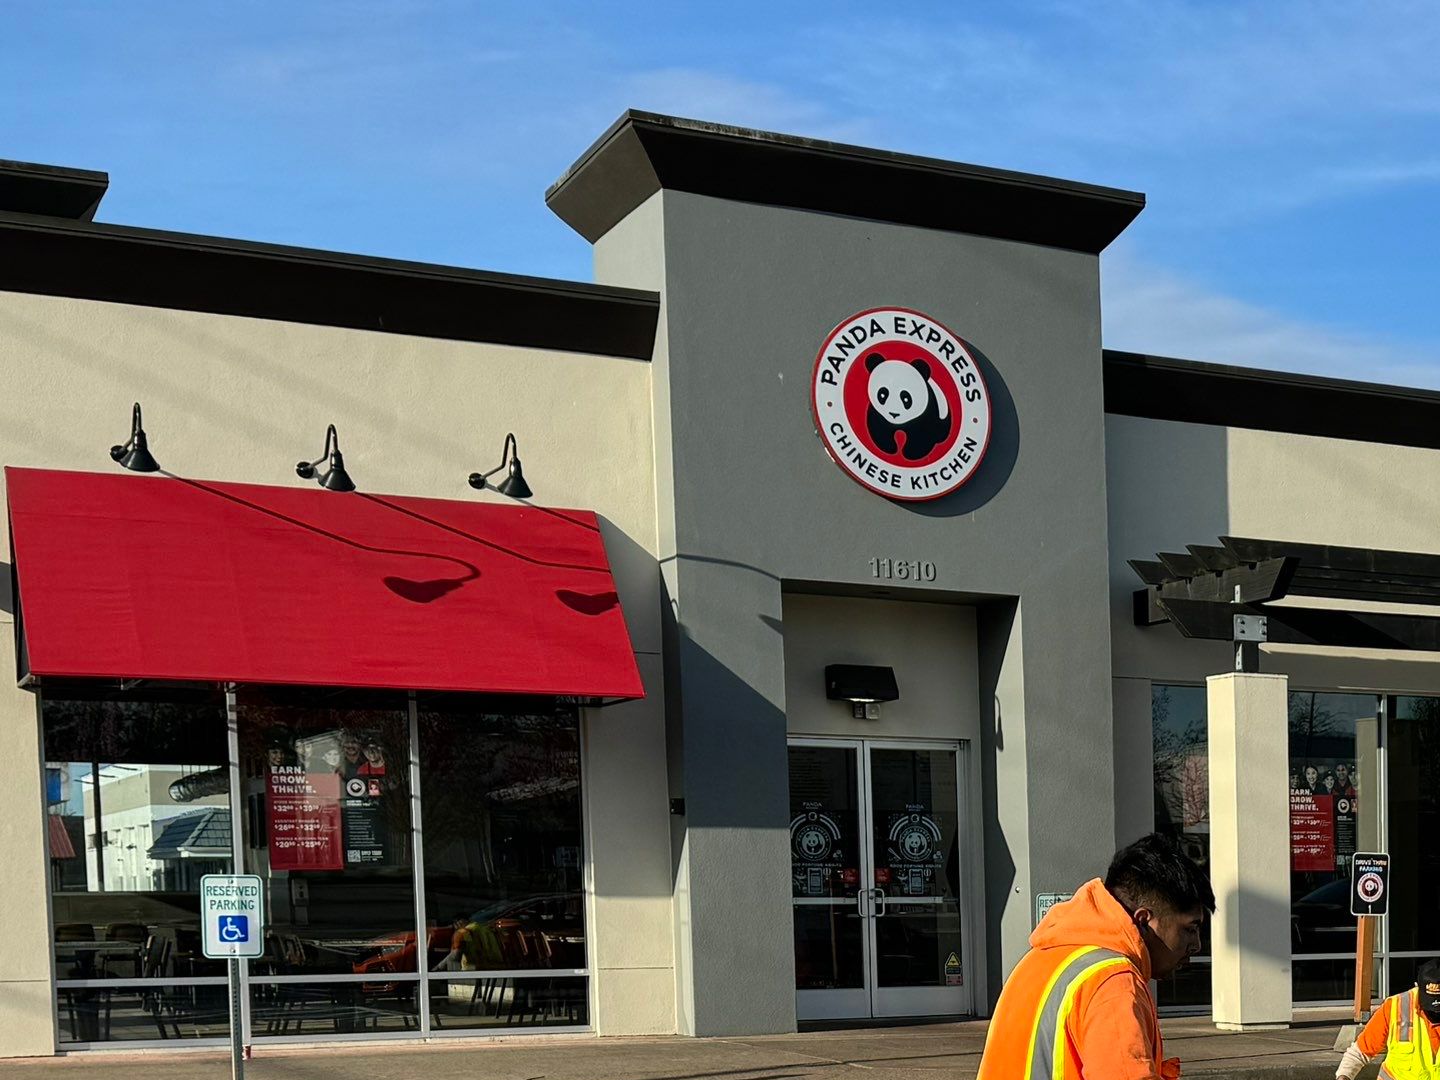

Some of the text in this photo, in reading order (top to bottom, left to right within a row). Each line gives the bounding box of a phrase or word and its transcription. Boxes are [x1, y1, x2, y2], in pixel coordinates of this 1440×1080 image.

[820, 316, 982, 403] PANDA EXPRESS
[830, 422, 978, 490] CHINESE KITCHEN
[868, 557, 937, 582] 11610
[270, 765, 306, 775] EARN.
[271, 775, 309, 785] GROW.
[271, 785, 317, 794] THRIVE.
[205, 885, 258, 897] RESERVED
[209, 899, 255, 910] PARKING
